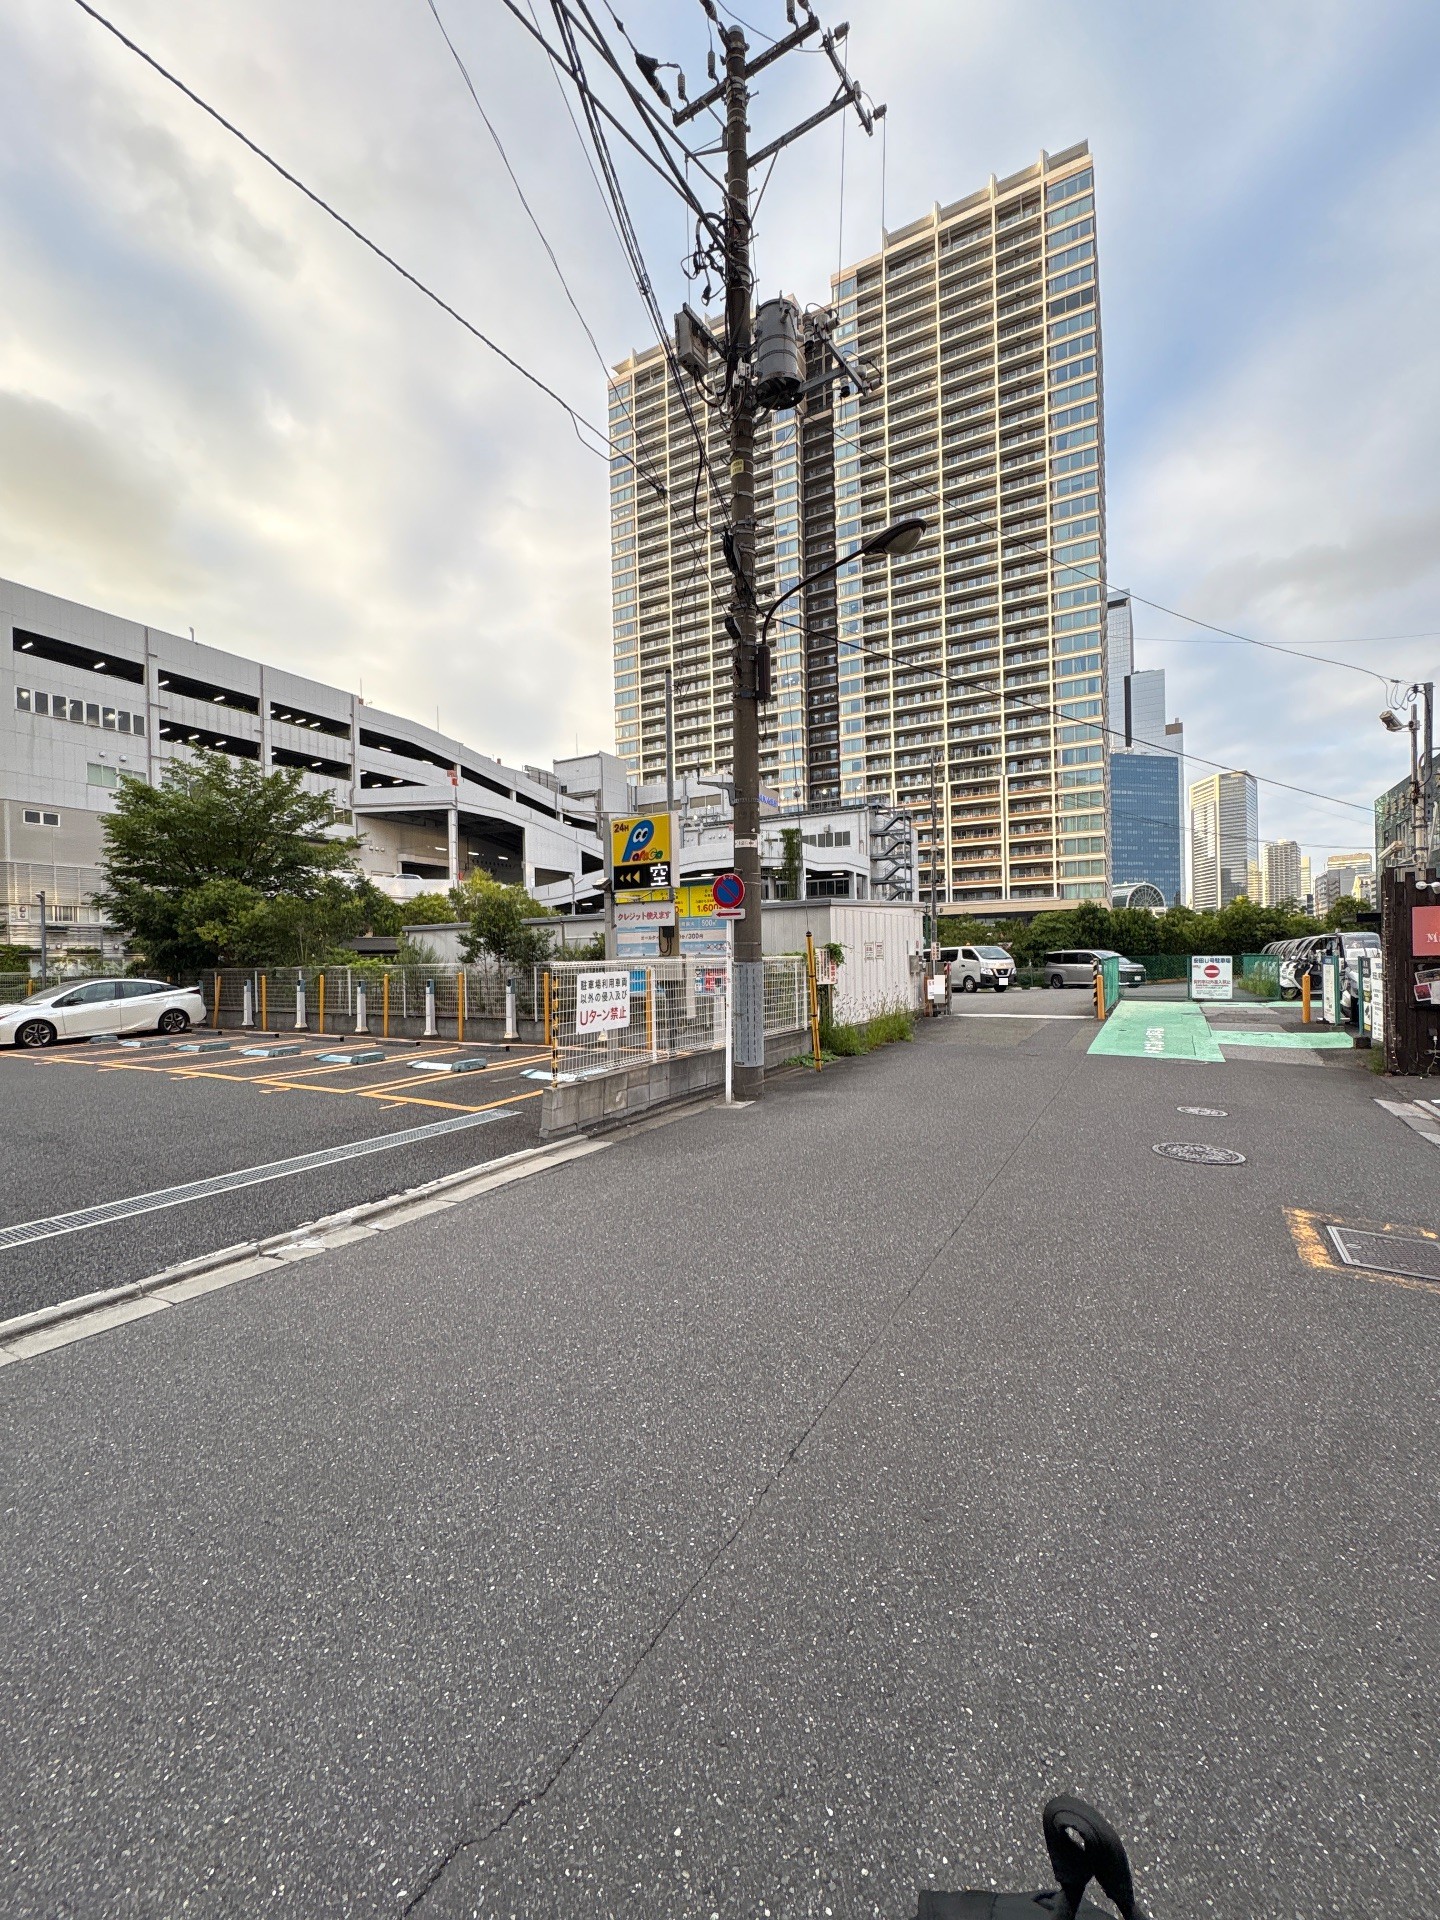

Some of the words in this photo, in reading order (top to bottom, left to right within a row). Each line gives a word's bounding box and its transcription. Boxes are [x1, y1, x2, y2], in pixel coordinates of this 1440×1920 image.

[614, 823, 629, 833] 24H
[649, 863, 669, 887] 空
[617, 911, 671, 921] クレジット使えます
[1426, 931, 1440, 943] M
[580, 977, 628, 991] 駐車場利用車両
[580, 990, 628, 1004] 以外の侵入及び
[579, 1005, 628, 1026] Uターン禁止
